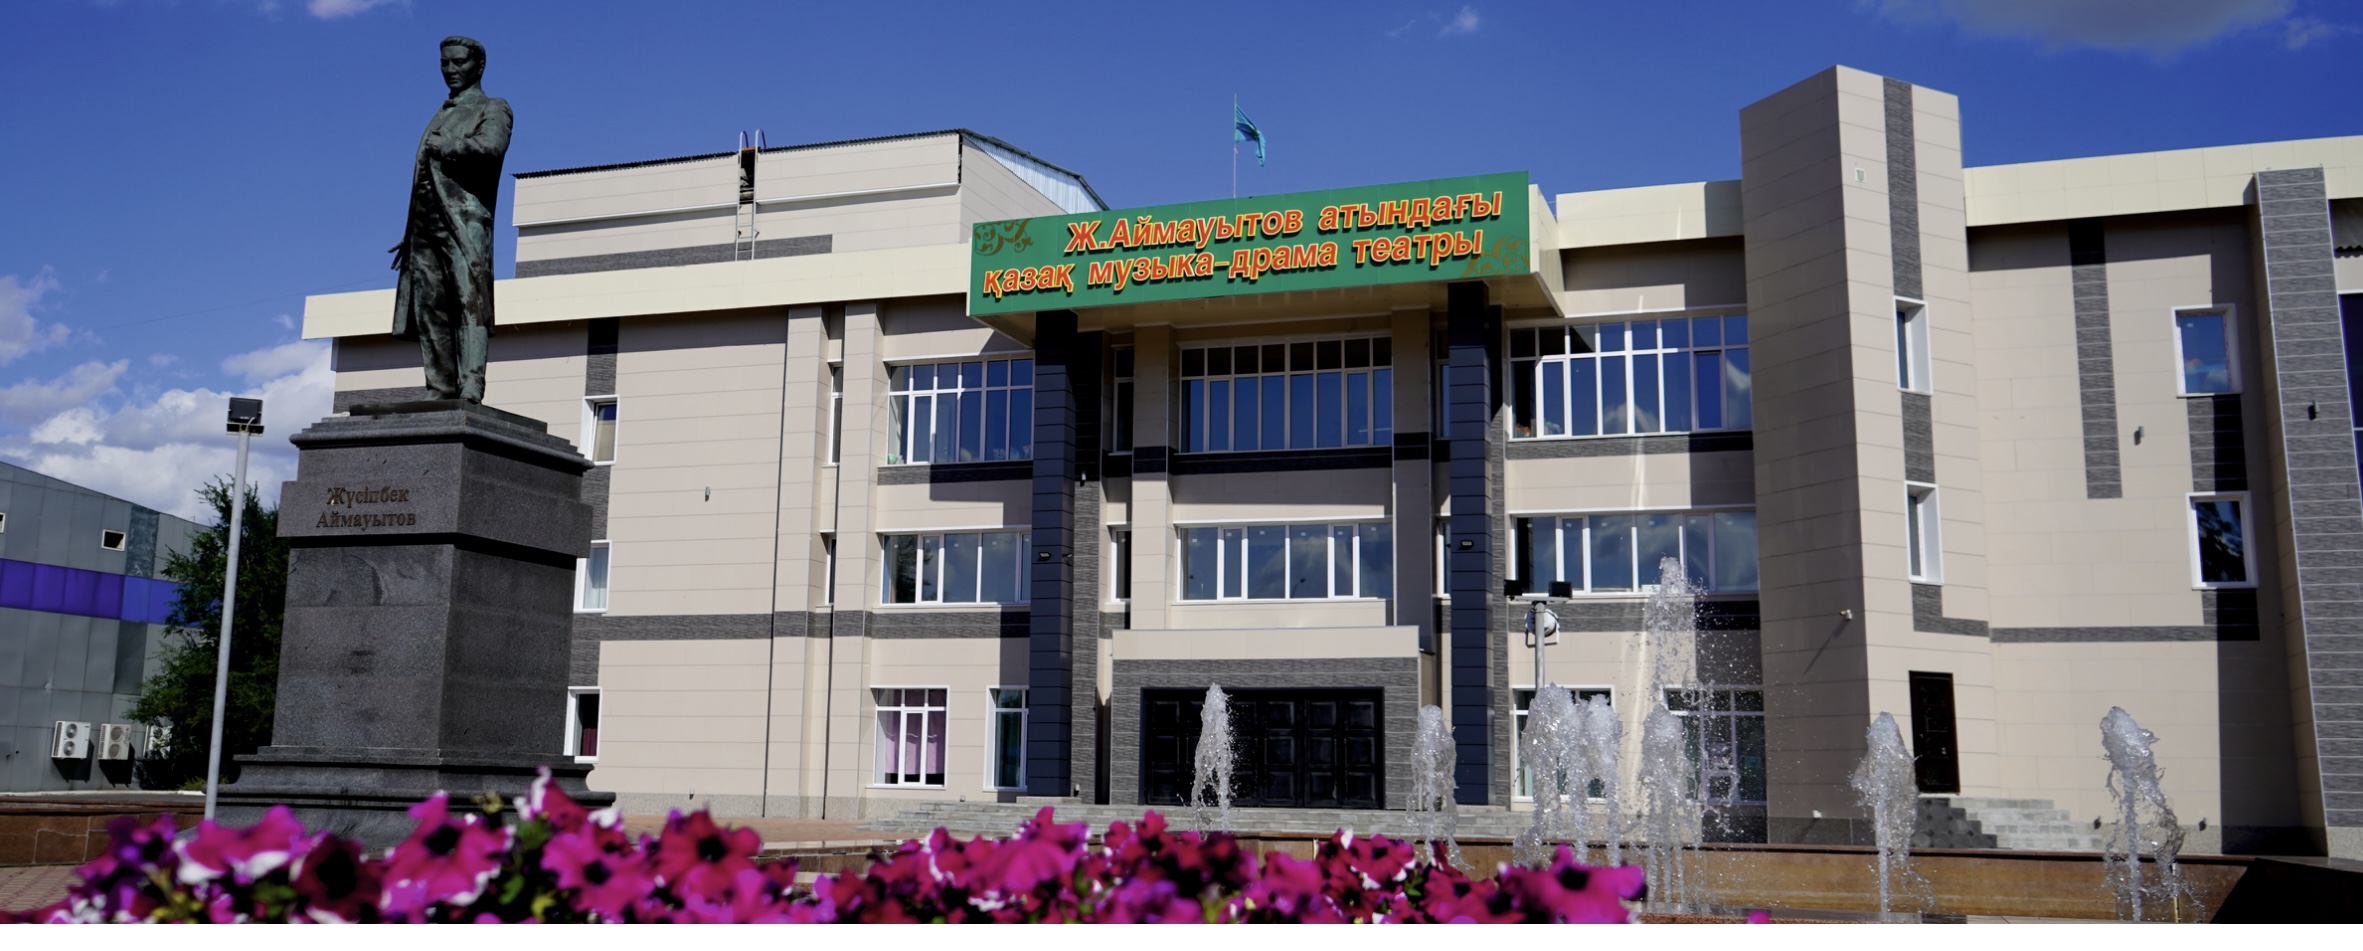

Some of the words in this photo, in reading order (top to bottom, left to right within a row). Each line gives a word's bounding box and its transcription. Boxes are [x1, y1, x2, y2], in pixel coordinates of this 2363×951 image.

[1064, 209, 1303, 253] Ж.Аймауытов
[1318, 191, 1503, 231] атындағы
[983, 263, 1074, 298] қазақ
[1087, 241, 1338, 292] музыка-драма
[1353, 229, 1483, 266] театры
[326, 486, 409, 508] Жүсіпбек
[316, 511, 416, 531] Аймауытов
